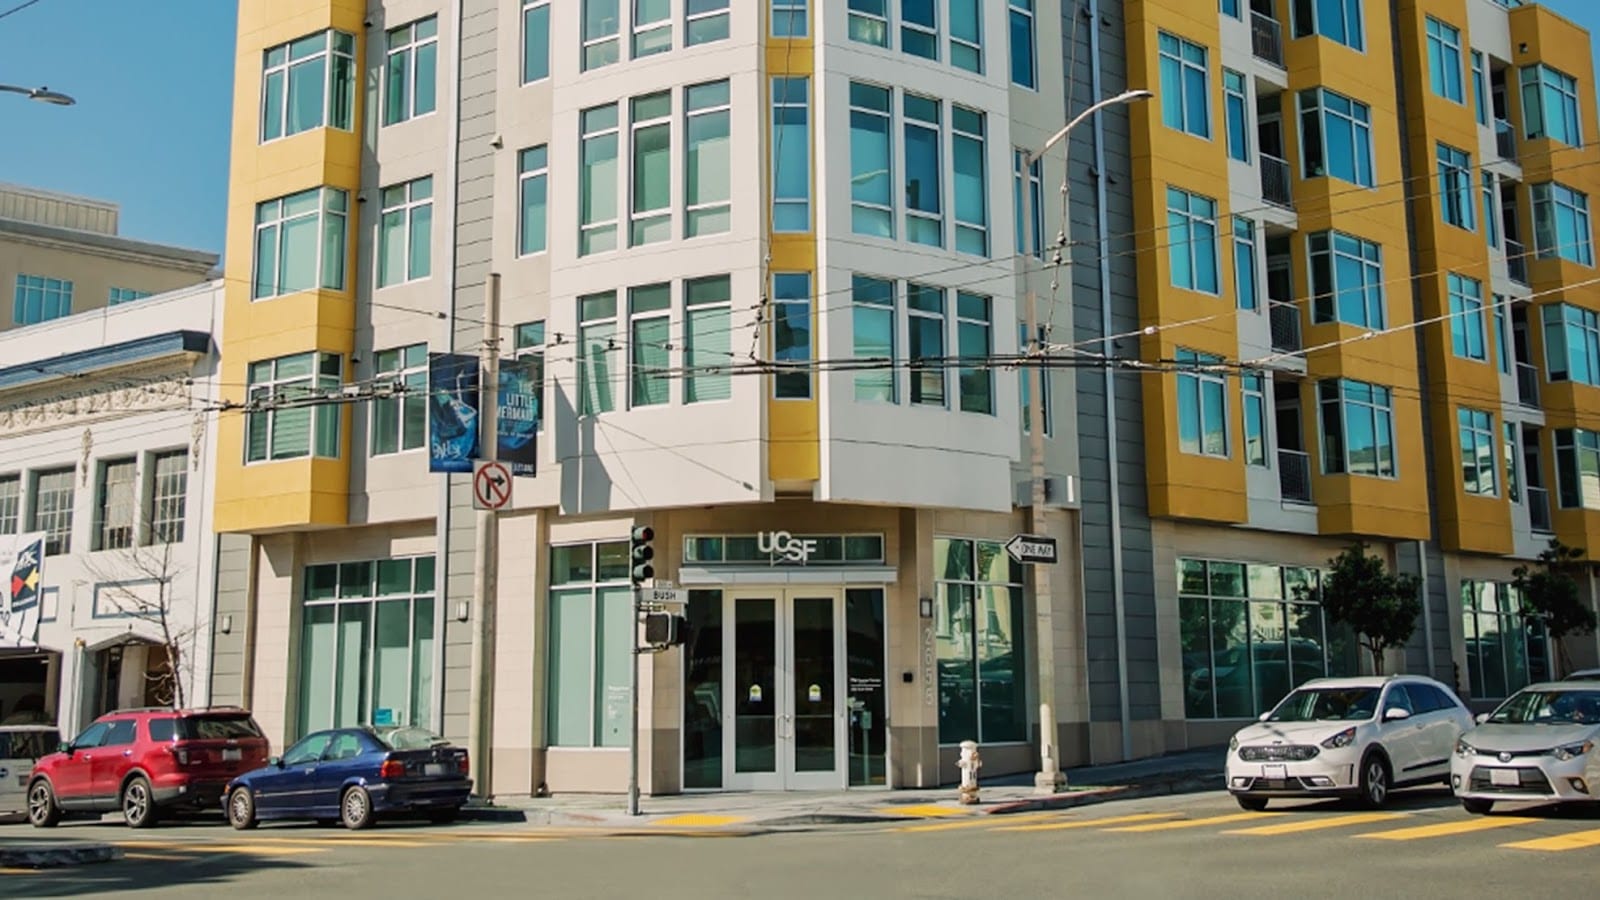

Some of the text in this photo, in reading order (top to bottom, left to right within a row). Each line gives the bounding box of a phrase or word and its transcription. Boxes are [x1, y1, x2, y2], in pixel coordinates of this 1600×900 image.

[506, 393, 535, 408] LITTLE
[758, 531, 817, 562] UCSF
[1021, 543, 1052, 556] ONE WAY
[653, 590, 677, 601] BUSH
